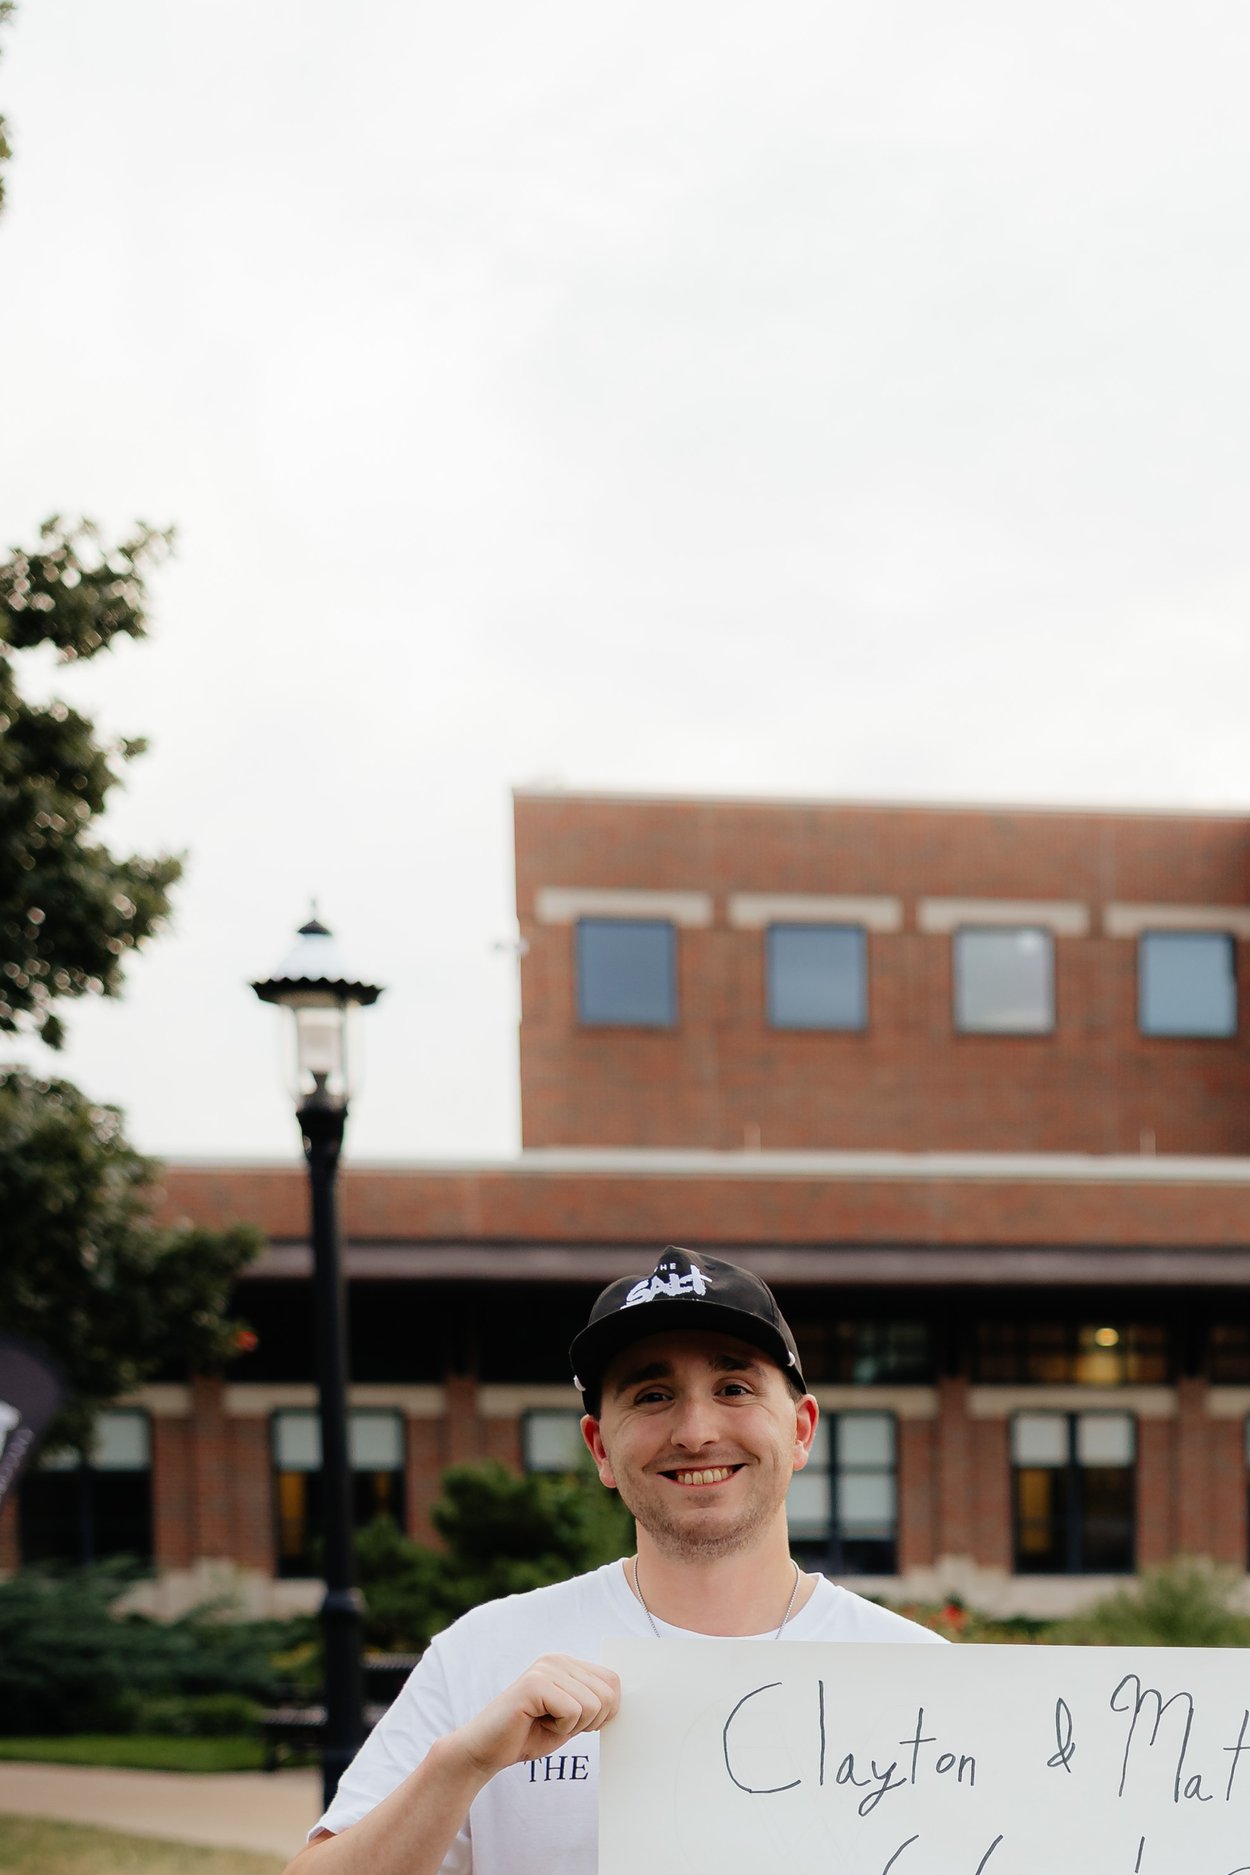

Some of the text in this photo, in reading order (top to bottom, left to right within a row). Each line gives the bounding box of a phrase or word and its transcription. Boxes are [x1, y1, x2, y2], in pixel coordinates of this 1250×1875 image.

[523, 1755, 590, 1783] THE
[722, 1679, 976, 1818] Clayton
[1046, 1696, 1077, 1774] &
